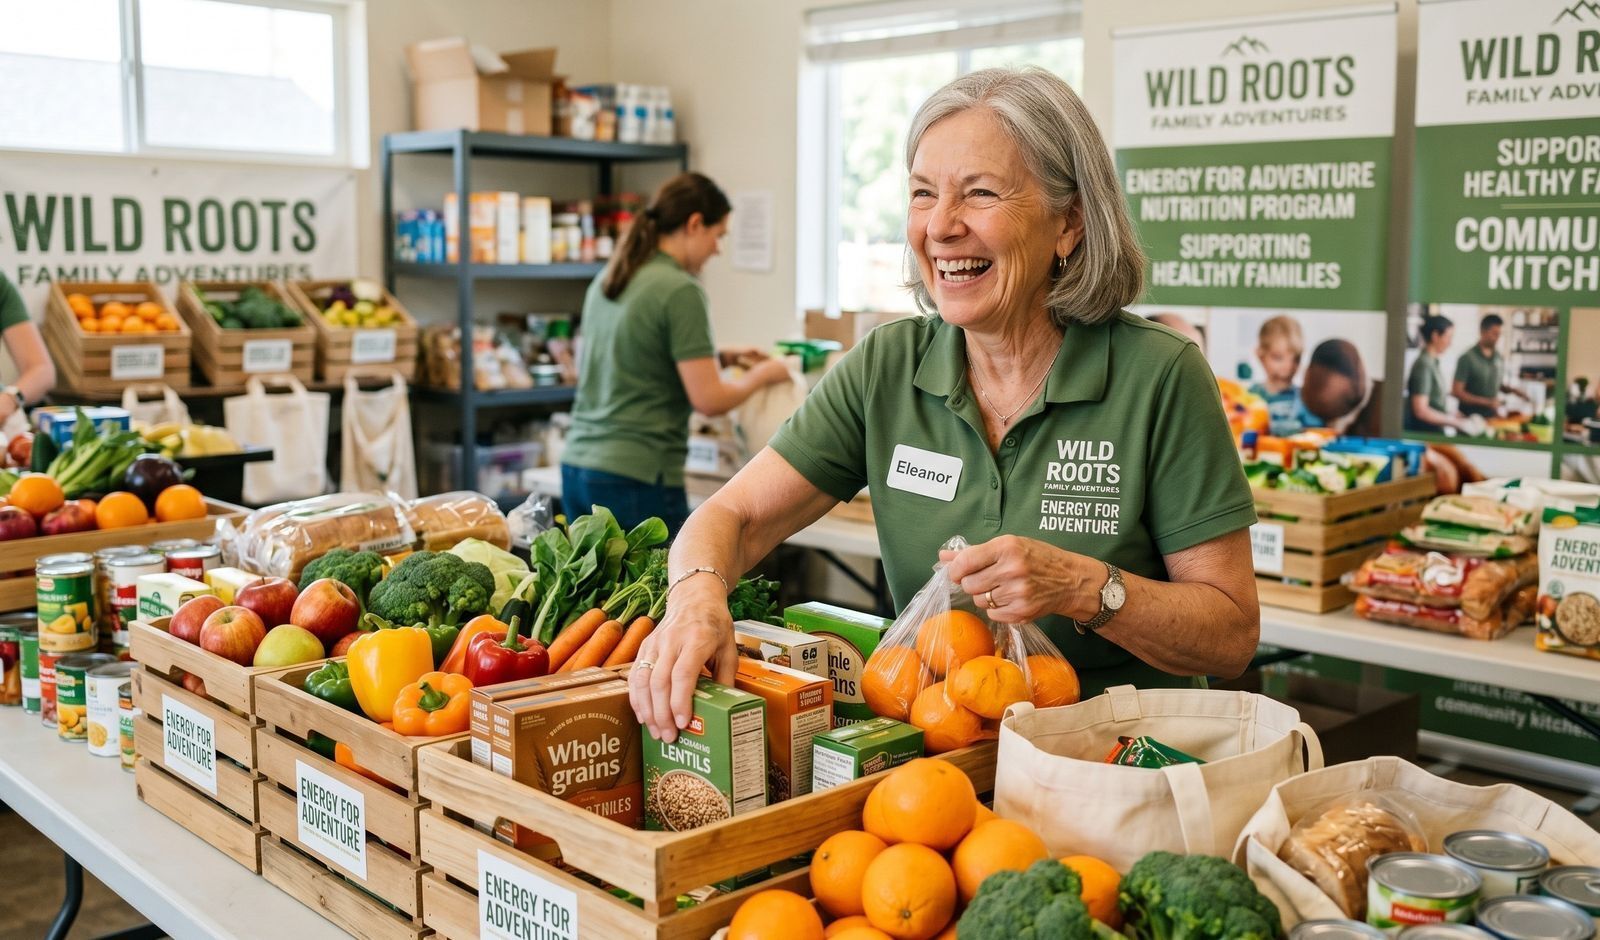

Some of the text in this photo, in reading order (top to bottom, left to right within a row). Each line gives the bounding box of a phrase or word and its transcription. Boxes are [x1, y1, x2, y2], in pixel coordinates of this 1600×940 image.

[1460, 34, 1560, 81] WILD
[1146, 56, 1355, 108] WILD ROOTS
[1467, 87, 1543, 105] FAMILY
[1151, 106, 1347, 129] FAMILY ADVENTURES
[1127, 161, 1376, 194] ENERGY FOR ADVENTURE
[1463, 169, 1576, 198] HEALTHY
[5, 194, 316, 253] WILD ROOTS
[1141, 193, 1355, 221] NUTRITION PROGRAM
[1180, 233, 1311, 260] SUPPORTING
[1455, 216, 1600, 252] COMMU
[18, 264, 313, 285] FAMILY ADVENTURES
[1152, 262, 1341, 289] HEALTHY FAMILIES
[1057, 440, 1114, 461] WILD
[896, 460, 952, 485] Eleanor
[1044, 483, 1120, 494] FAMILY ADVENTURES
[1046, 462, 1121, 484] ROOTS
[1040, 500, 1119, 518] ENERGY FOR
[1039, 518, 1119, 535] ADVENTURE
[166, 709, 195, 738] ENERGY
[197, 726, 212, 749] FOR
[1435, 696, 1526, 730] community
[166, 730, 212, 771] ADVENTURE
[547, 733, 620, 766] Whole
[661, 741, 711, 774] LENTILS
[552, 759, 621, 796] grains
[301, 777, 360, 828] ENERGY FOR
[302, 802, 361, 853] ADVENTURE
[485, 871, 570, 934] ENERGY FOR
[486, 900, 570, 940] ADVENTU
